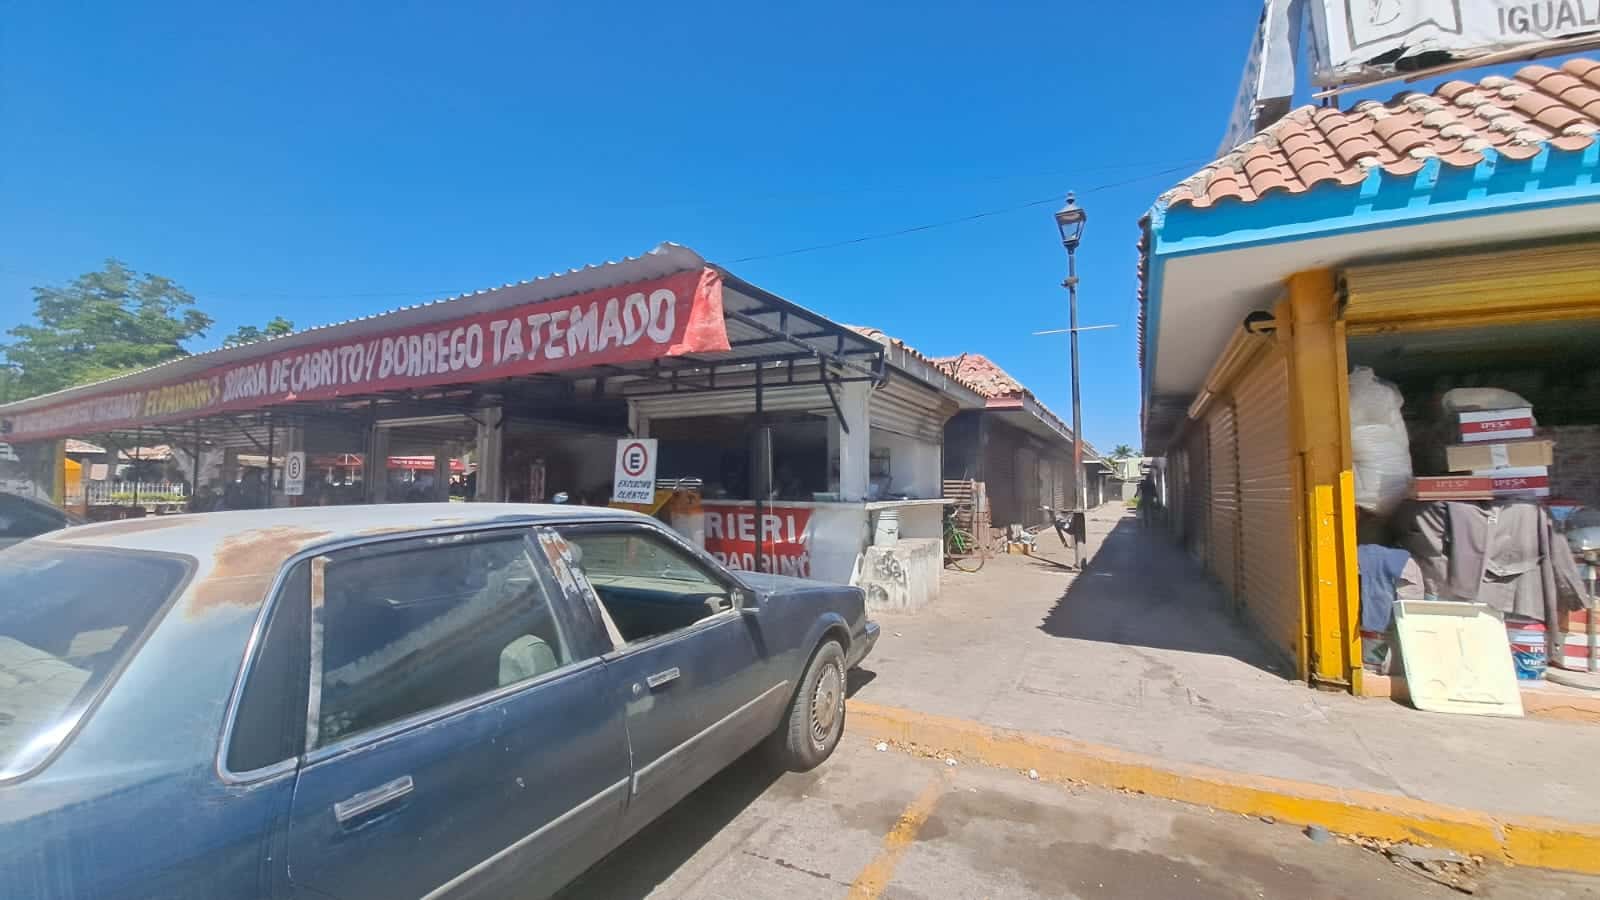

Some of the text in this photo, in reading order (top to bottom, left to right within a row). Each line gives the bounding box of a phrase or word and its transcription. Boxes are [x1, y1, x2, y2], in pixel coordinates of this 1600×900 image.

[1497, 0, 1600, 35] IGUAL
[223, 362, 268, 401] BIRRIA
[269, 358, 291, 394] DE
[291, 343, 364, 393] CABRITO
[378, 323, 484, 379] BORREGO
[490, 288, 677, 366] TATEMADO
[630, 452, 641, 469] E
